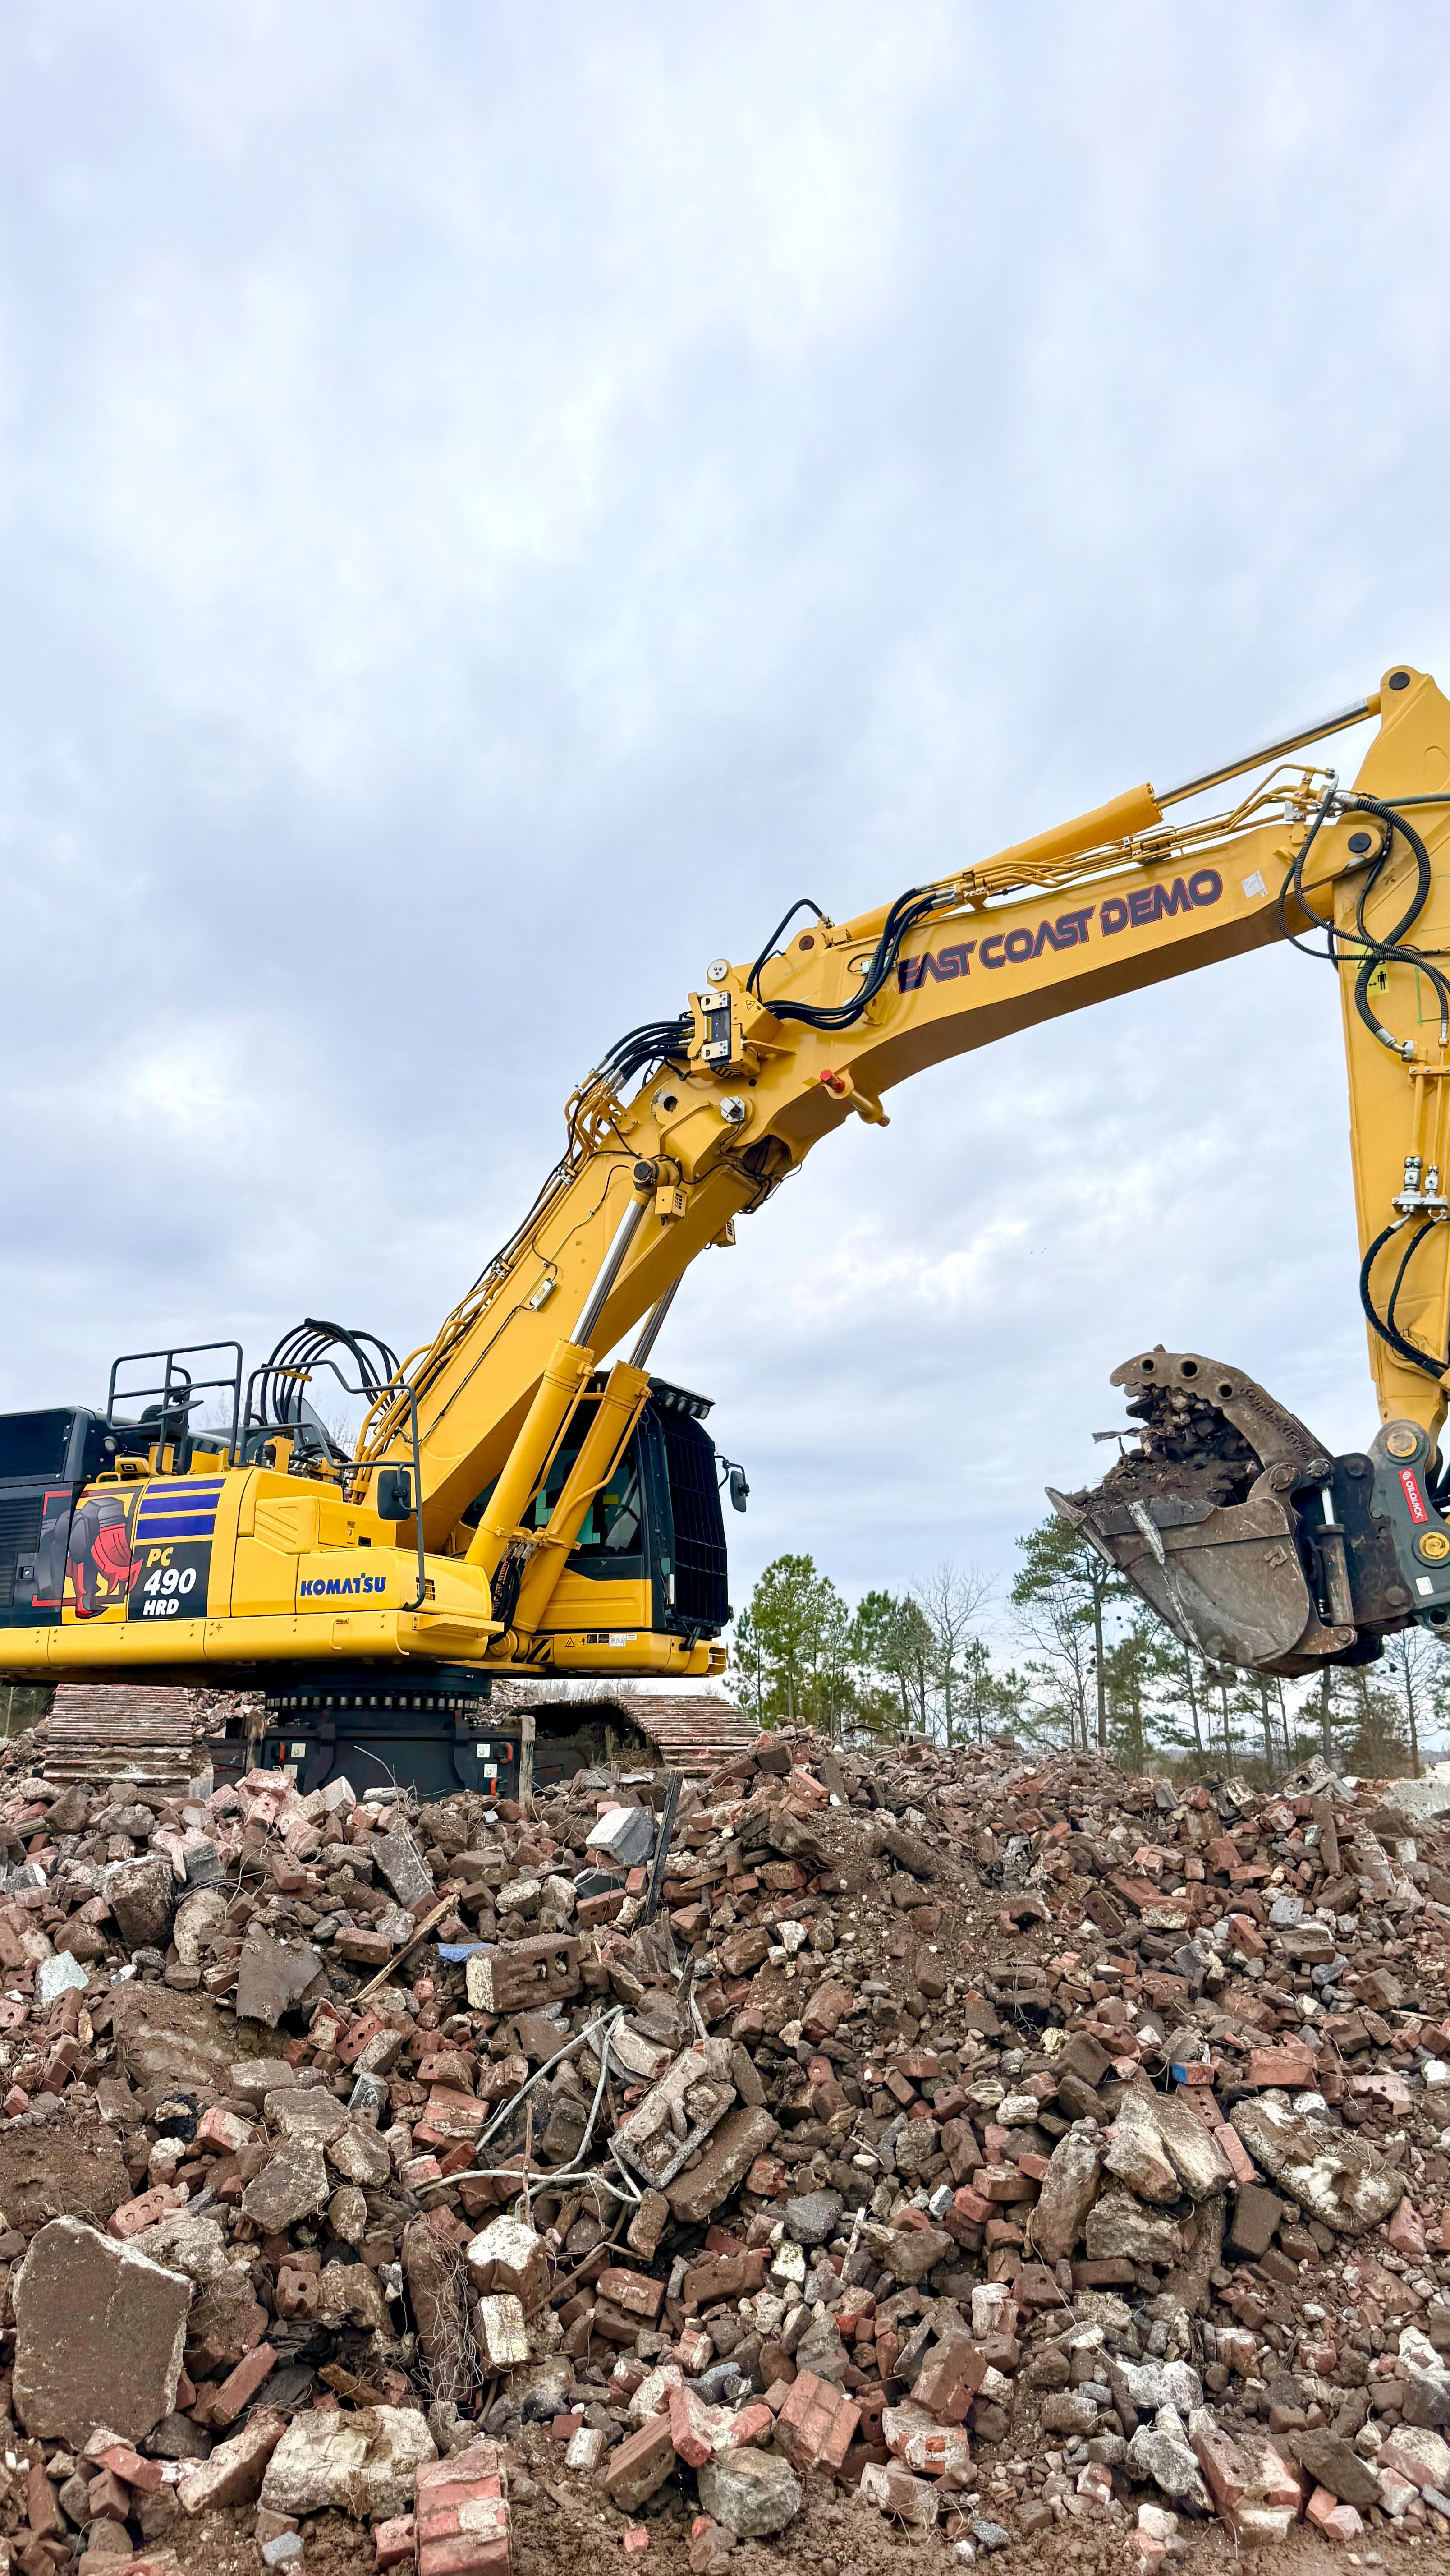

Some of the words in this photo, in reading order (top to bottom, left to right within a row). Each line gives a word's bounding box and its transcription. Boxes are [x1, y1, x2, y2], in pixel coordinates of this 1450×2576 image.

[897, 940, 977, 994] EAST
[978, 905, 1096, 970] COAST
[1099, 868, 1223, 937] DEMO
[1405, 1481, 1424, 1518] OILQUICK
[146, 1547, 174, 1568] PC
[143, 1568, 197, 1596] 490
[300, 1573, 386, 1596] KOMATSU
[142, 1599, 179, 1616] HRD
